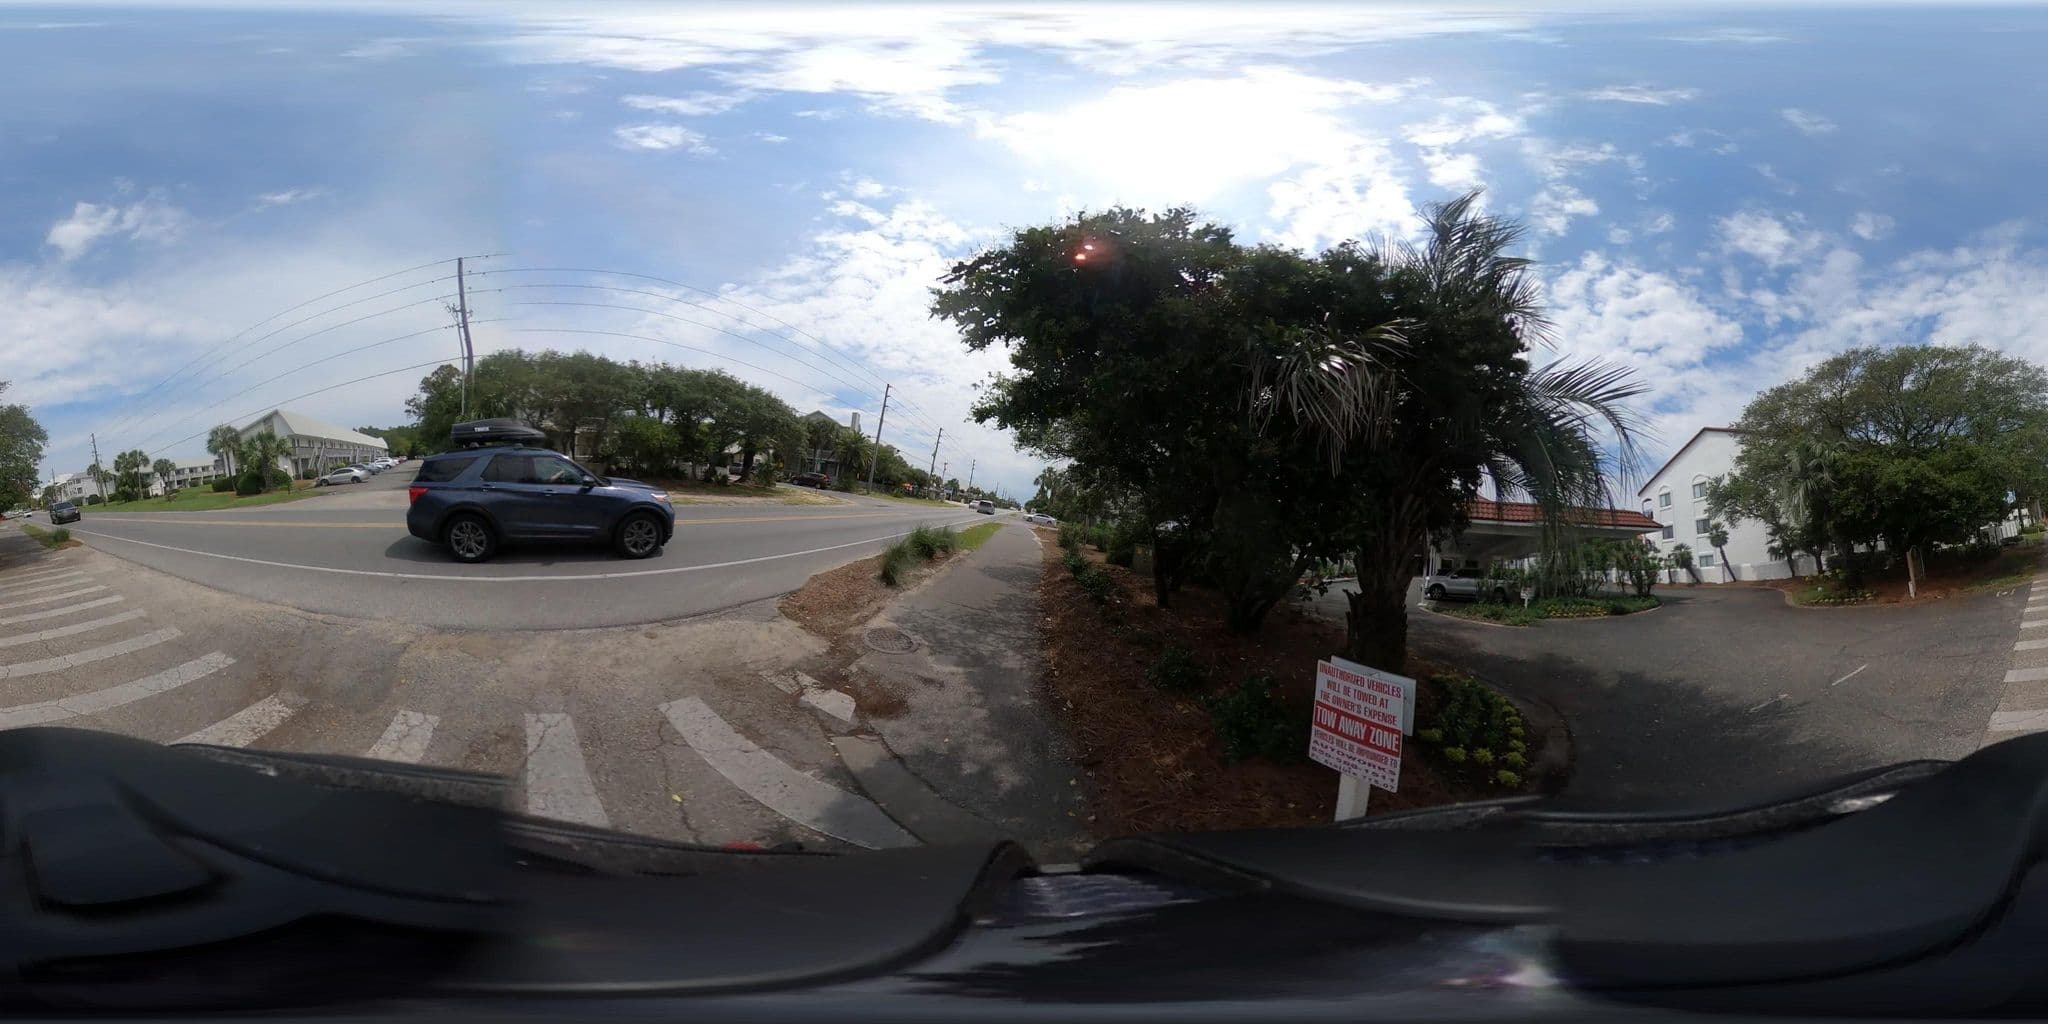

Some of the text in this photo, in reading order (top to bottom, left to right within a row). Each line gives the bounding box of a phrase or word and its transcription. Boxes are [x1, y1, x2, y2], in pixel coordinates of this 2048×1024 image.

[1327, 680, 1389, 709] WILL BE TOWED AT
[1367, 677, 1401, 699] VEHICLES
[1320, 690, 1397, 727] THE OWNER'S EXPENSE
[1316, 705, 1399, 753] TOW AWAY ZONE
[1313, 740, 1396, 775] AUTOWORKS
[1390, 757, 1397, 768] TO
